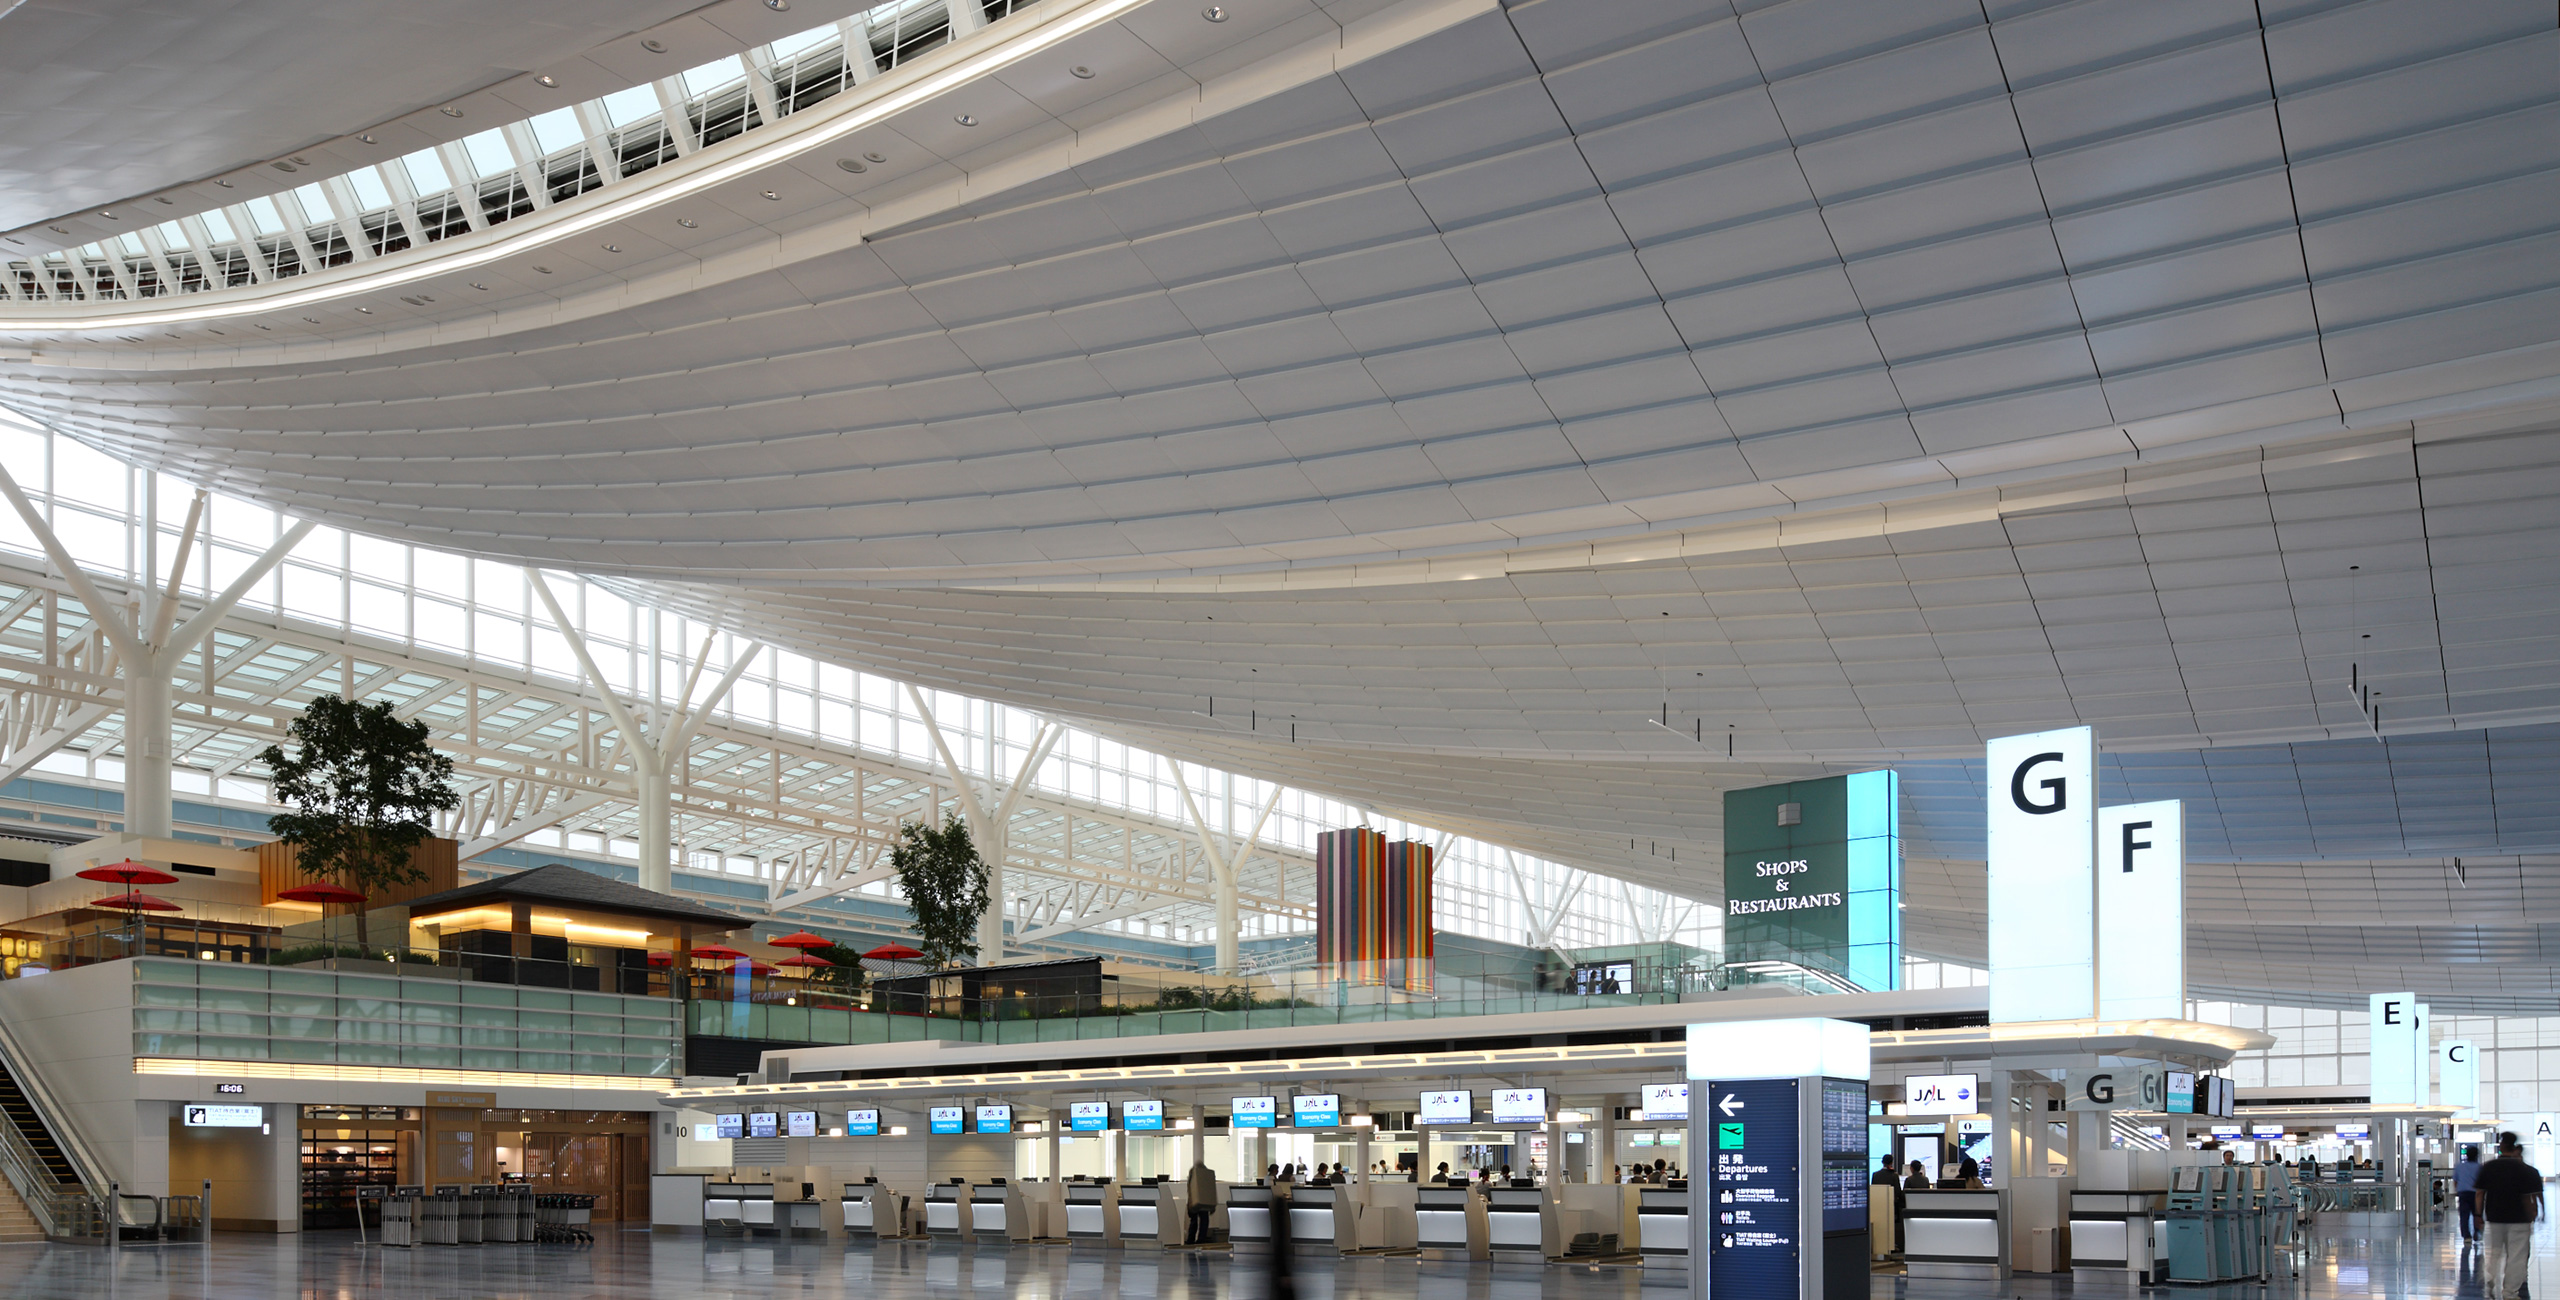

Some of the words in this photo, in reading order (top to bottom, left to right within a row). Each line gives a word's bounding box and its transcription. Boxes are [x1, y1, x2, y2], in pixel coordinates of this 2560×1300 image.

[2011, 752, 2066, 815] G
[2123, 821, 2152, 873] F
[1756, 860, 1808, 877] SHOPS
[1776, 879, 1789, 892] &
[1730, 893, 1841, 915] RESTAURANTS
[2385, 1002, 2400, 1025] E
[2449, 1046, 2464, 1062] C
[221, 1084, 242, 1092] 16:06
[1656, 1087, 1674, 1100] JAL
[2087, 1074, 2114, 1104] G
[2144, 1074, 2154, 1103] G
[1432, 1094, 1447, 1106] JAL
[1504, 1092, 1520, 1104] JAL
[1914, 1085, 1945, 1106] JAL
[2416, 1125, 2424, 1135] E
[2537, 1122, 2552, 1135] A
[1719, 1165, 1768, 1174] Departures
